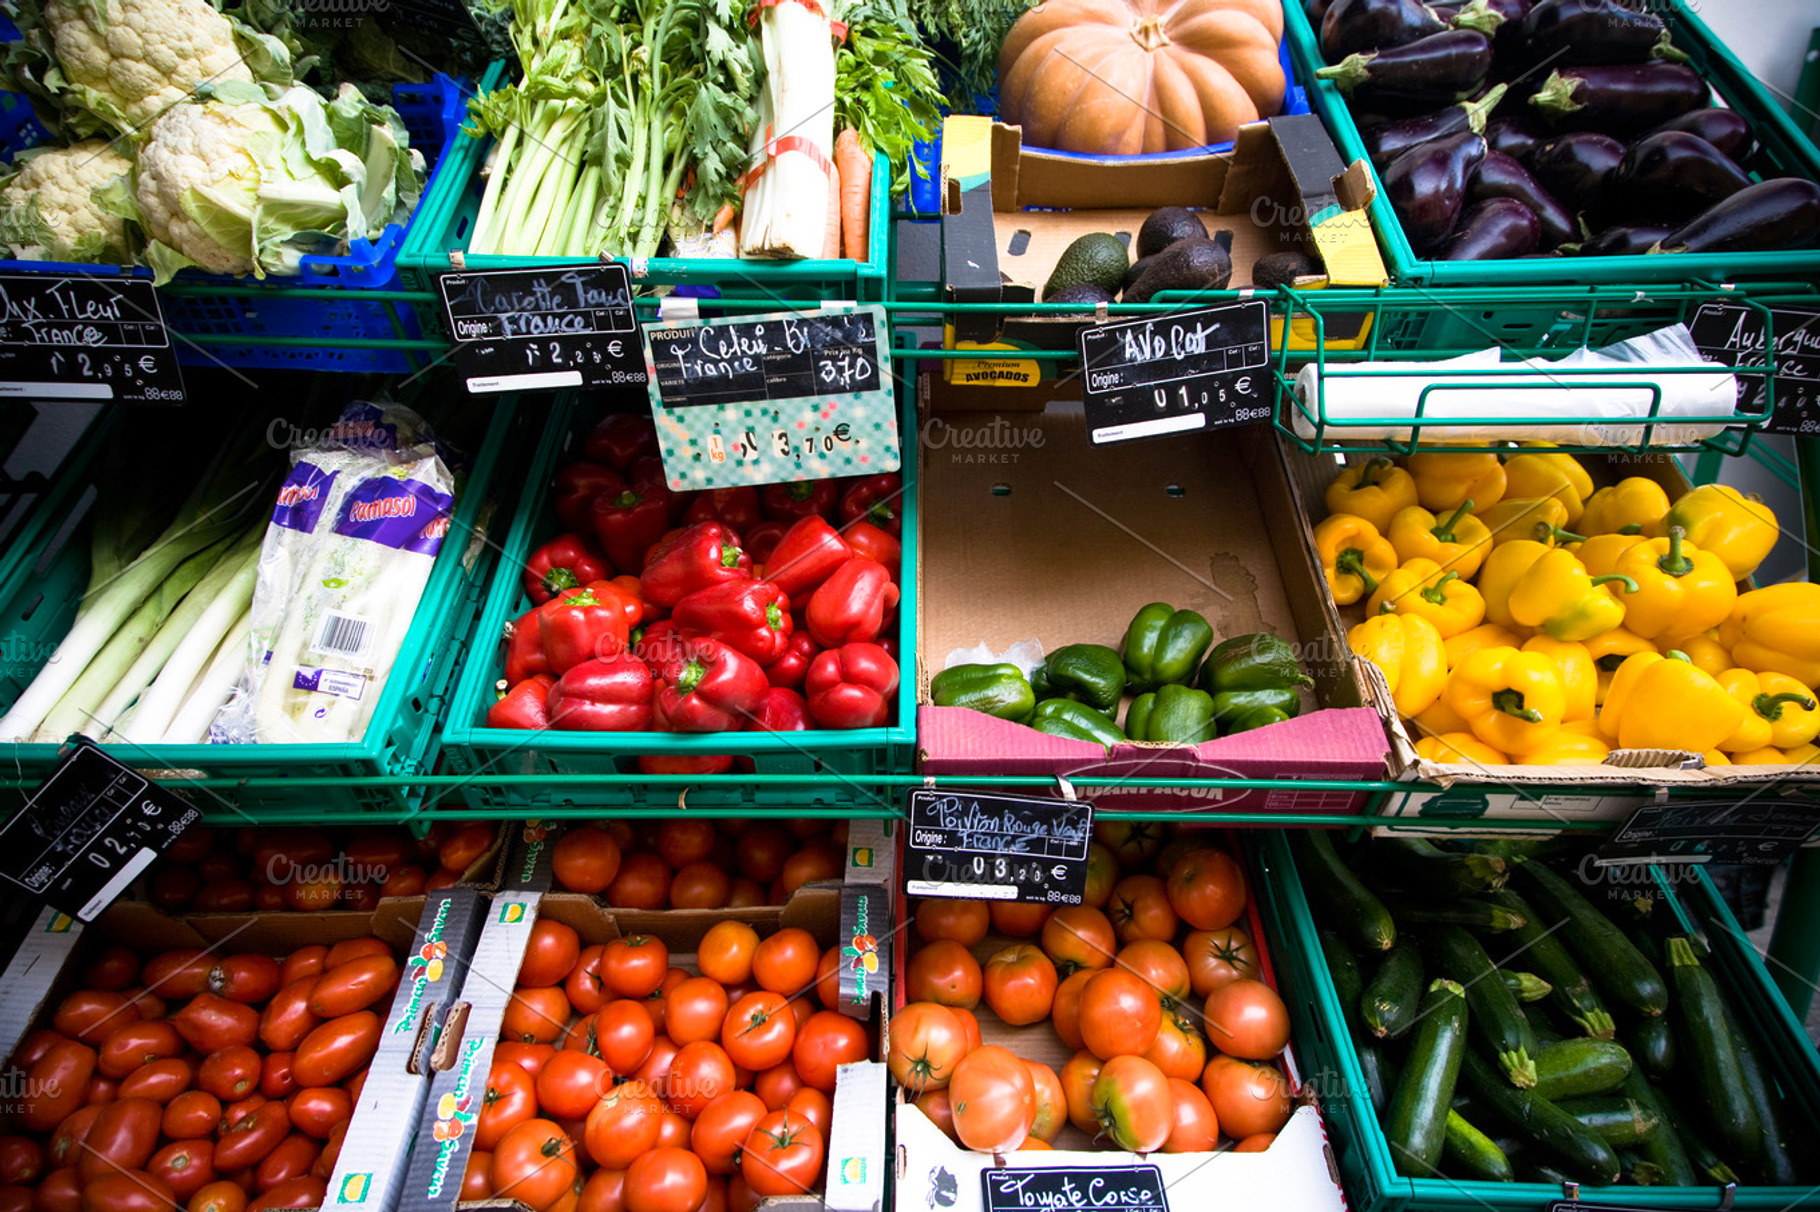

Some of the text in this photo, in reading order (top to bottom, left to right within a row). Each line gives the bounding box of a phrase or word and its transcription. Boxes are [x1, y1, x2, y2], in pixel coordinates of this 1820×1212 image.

[649, 326, 696, 342] PRODUIT
[966, 370, 1030, 382] AVOCADOS
[711, 449, 725, 462] kg
[350, 494, 416, 523] Pamasol
